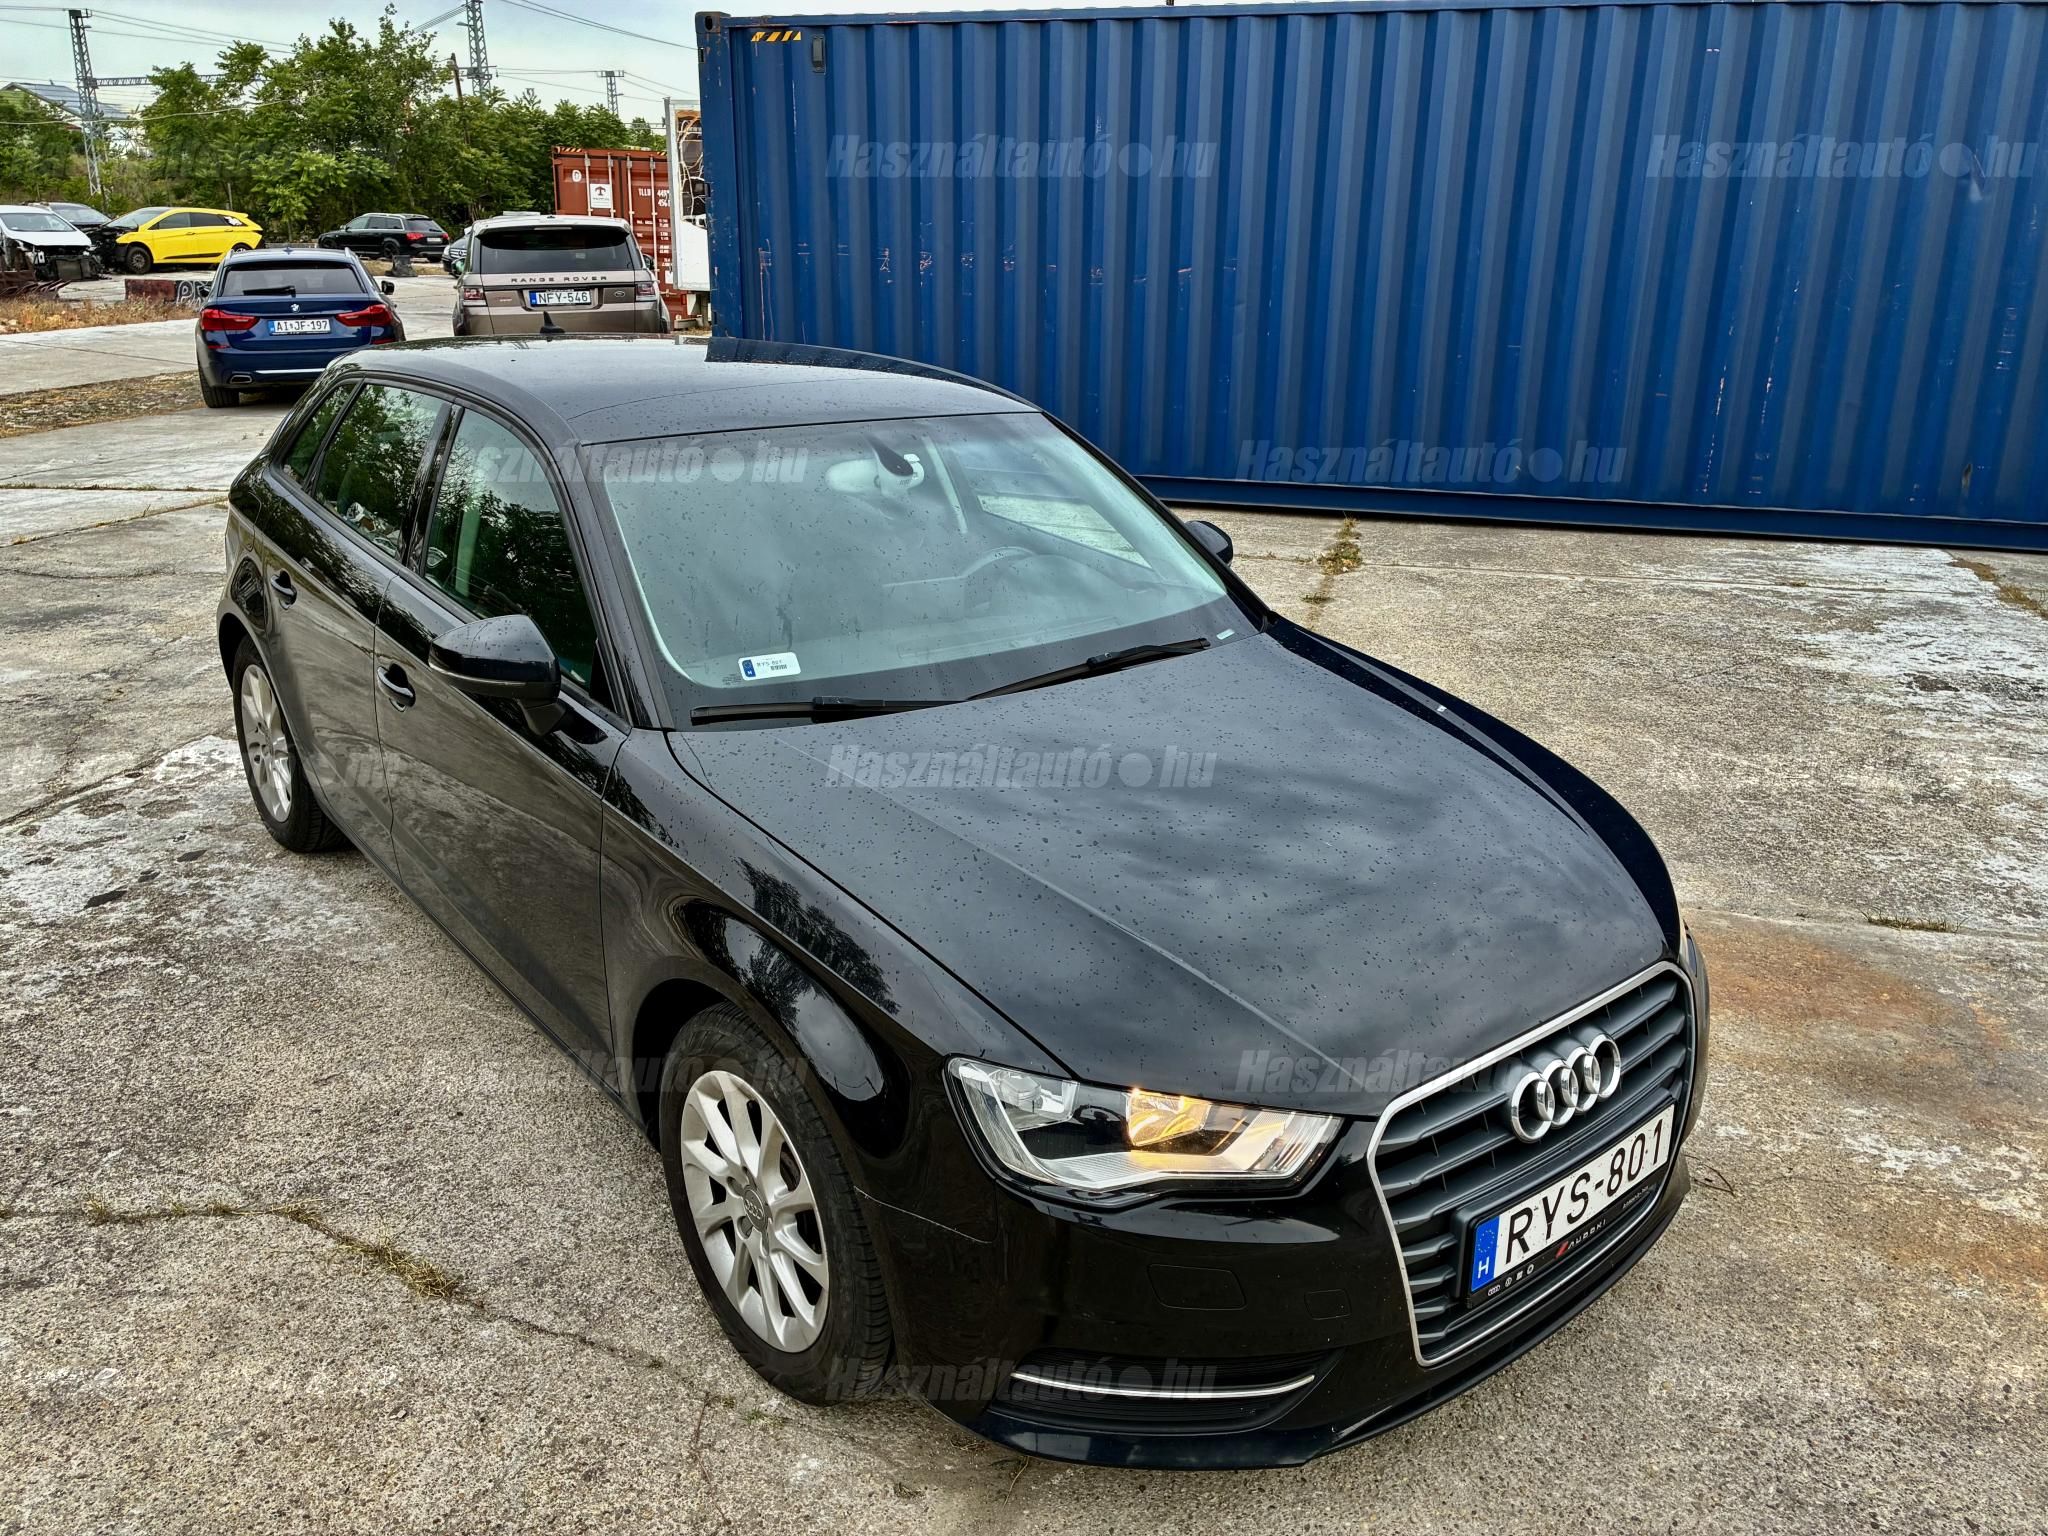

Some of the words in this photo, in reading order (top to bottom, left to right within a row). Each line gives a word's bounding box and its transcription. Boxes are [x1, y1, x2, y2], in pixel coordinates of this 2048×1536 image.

[538, 291, 588, 303] NFY-546
[1505, 1118, 1664, 1266] RYS-801
[1477, 1257, 1490, 1279] H
